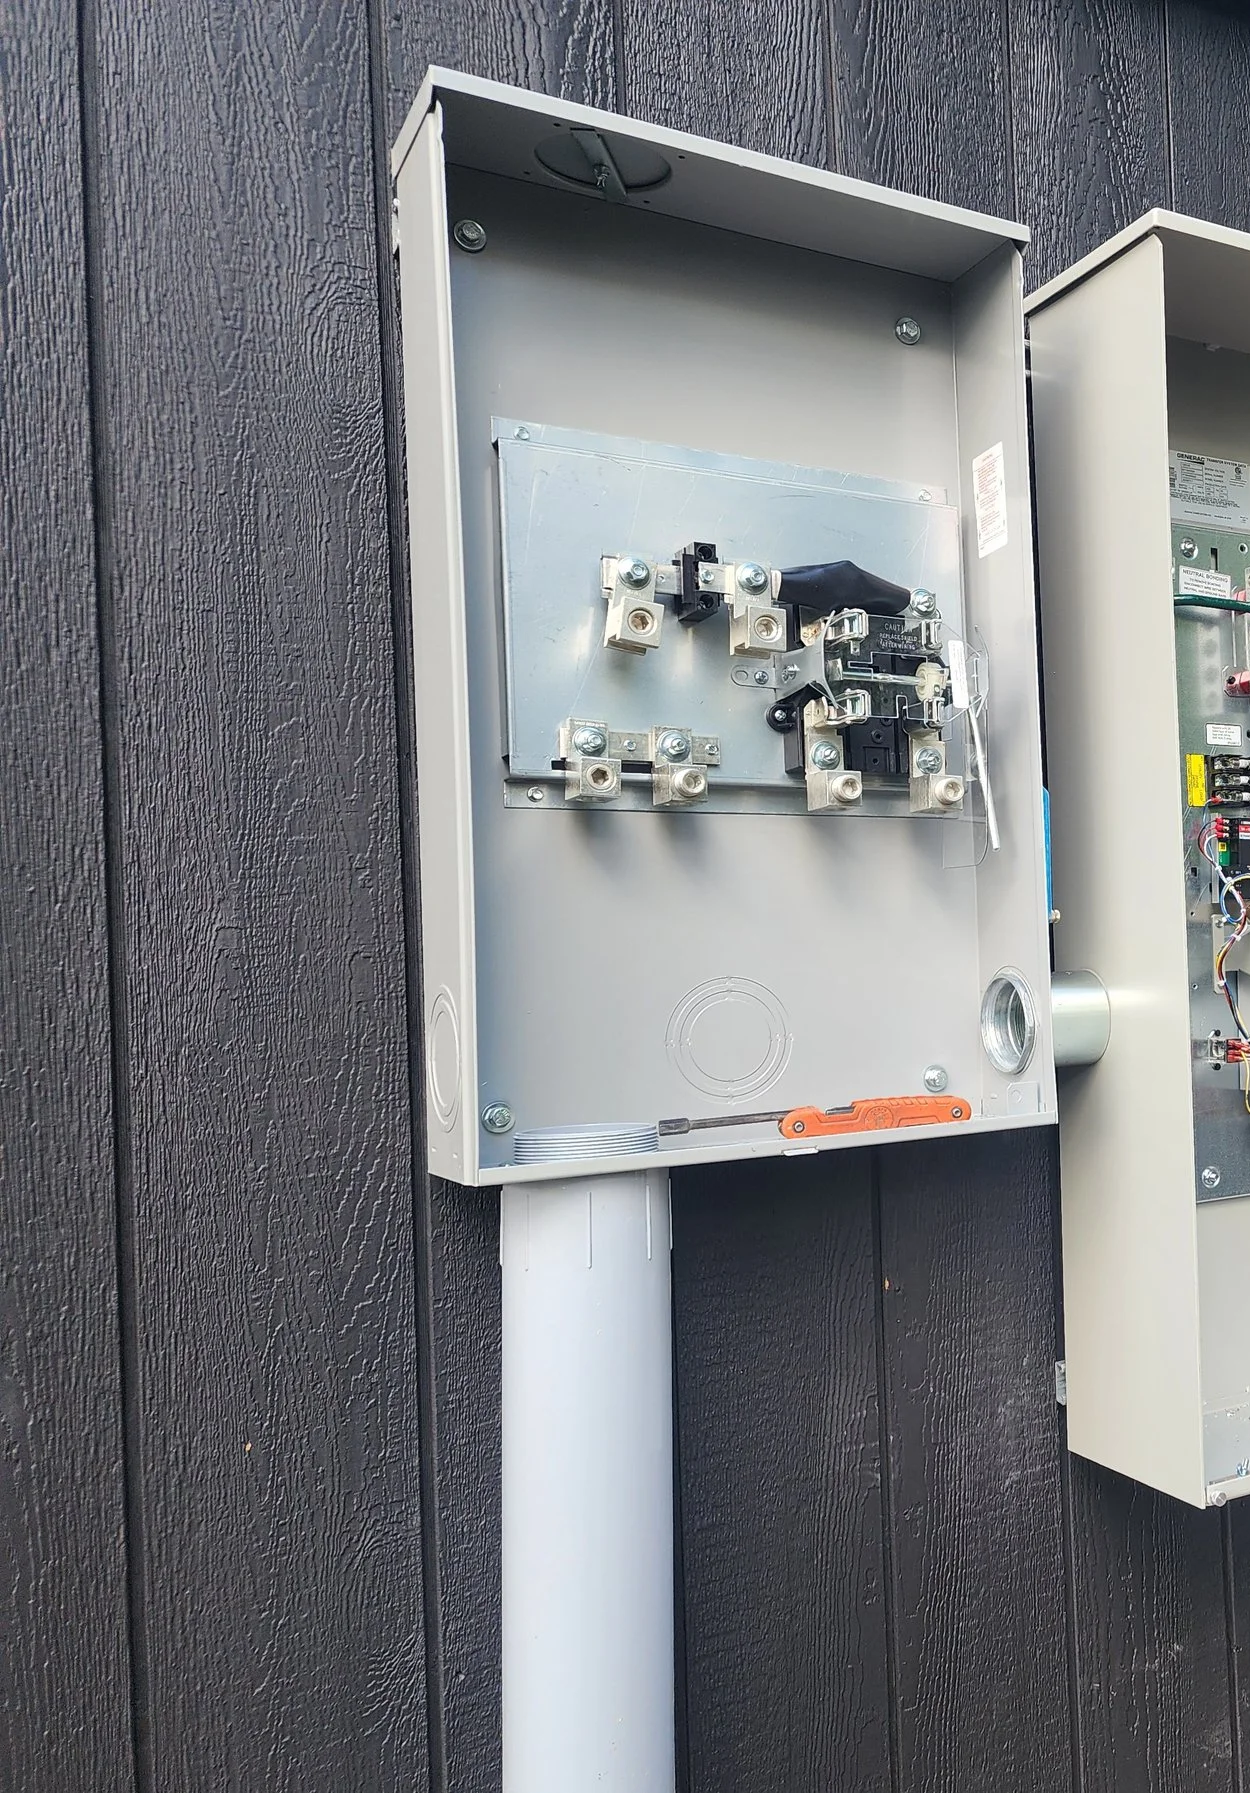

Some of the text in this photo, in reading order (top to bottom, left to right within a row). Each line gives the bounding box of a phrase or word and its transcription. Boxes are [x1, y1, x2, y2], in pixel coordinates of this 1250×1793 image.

[1176, 452, 1205, 463] GENERAC
[1182, 569, 1228, 583] NEUTRAL BONDING
[884, 622, 912, 633] CAUTI
